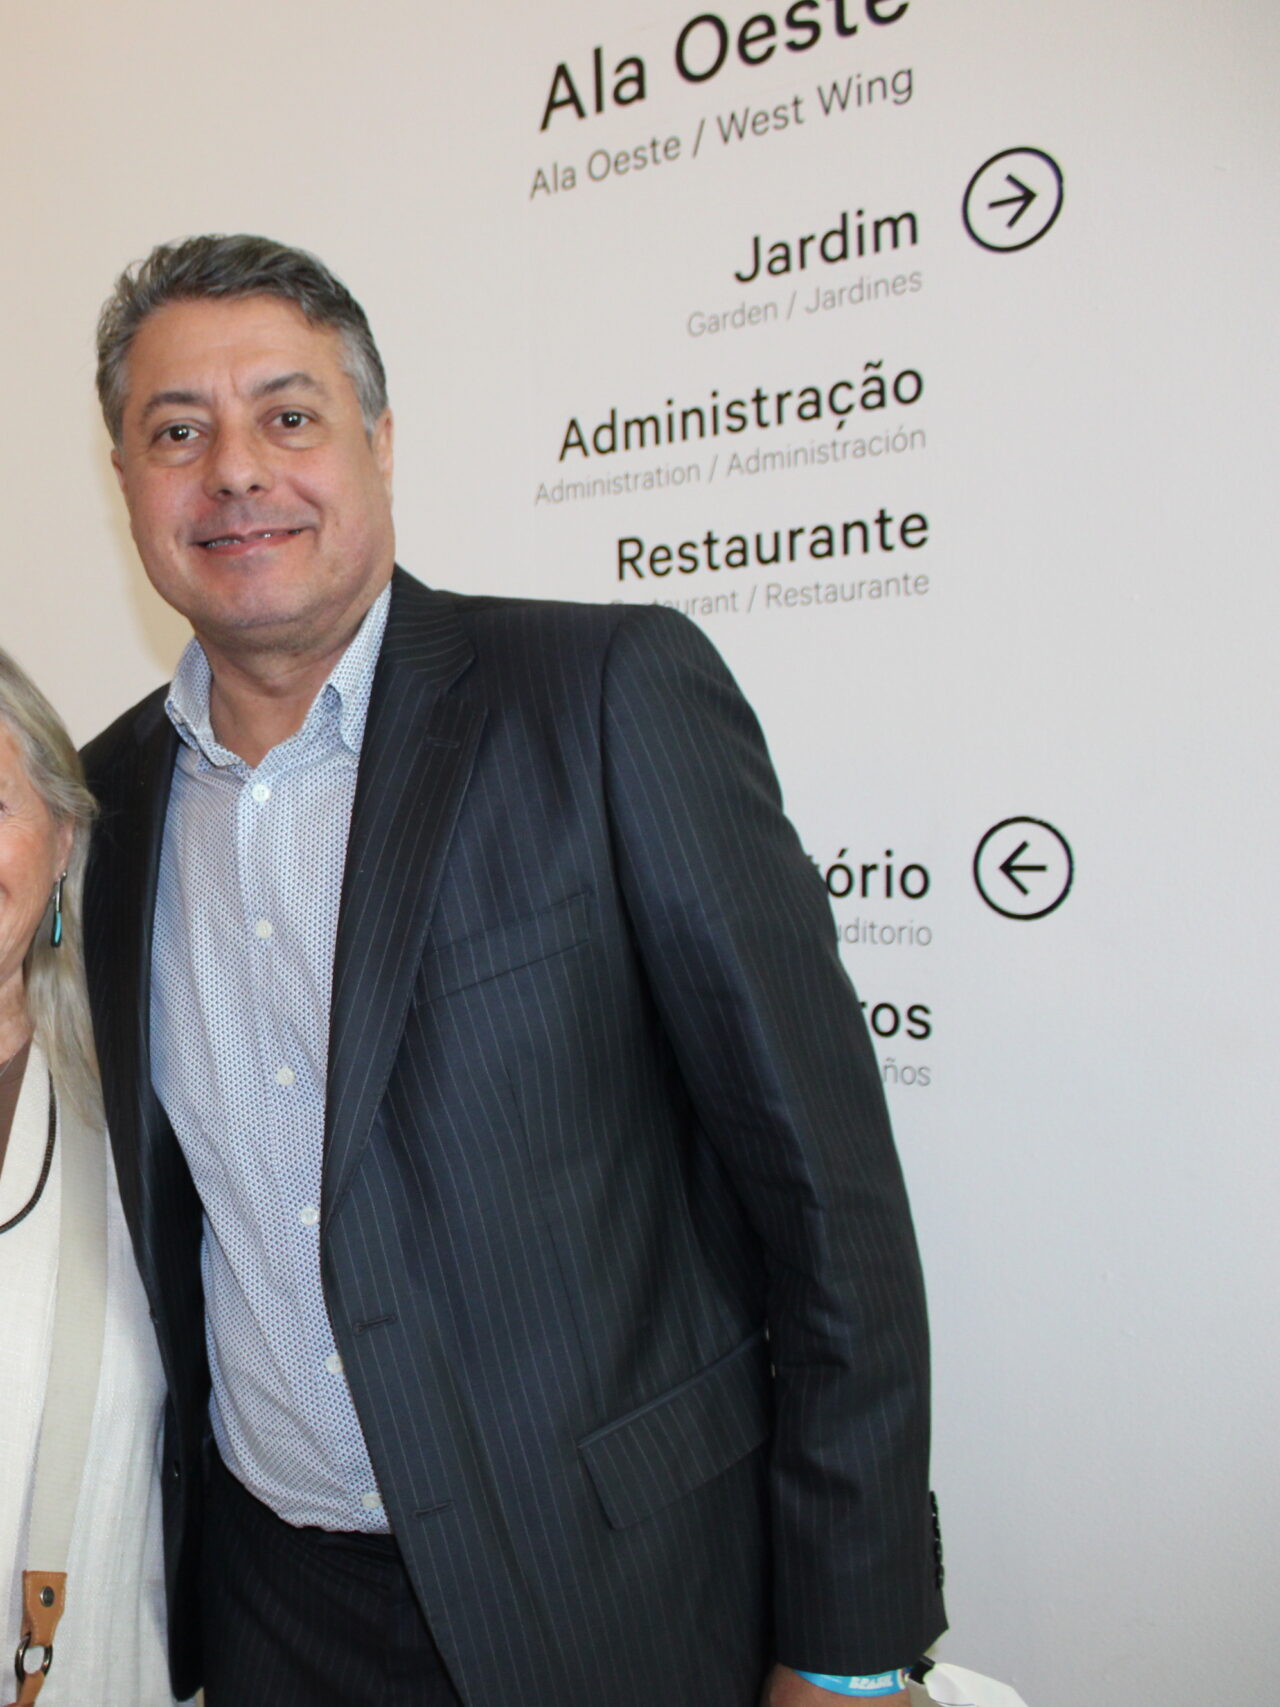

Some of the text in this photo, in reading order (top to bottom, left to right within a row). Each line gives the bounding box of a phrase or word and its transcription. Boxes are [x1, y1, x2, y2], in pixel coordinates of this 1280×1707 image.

[539, 45, 647, 133] Ala
[530, 68, 914, 200] Ala Oeste / West Wing
[733, 208, 920, 285] Jardim
[687, 271, 922, 338] Garden / Jardines
[558, 359, 925, 463] Administração
[535, 425, 926, 505] Administration / Administración
[616, 507, 930, 582] Restaurante
[610, 572, 930, 616] urant / Restaurante
[806, 847, 932, 901] ório
[883, 1056, 932, 1087] ños
